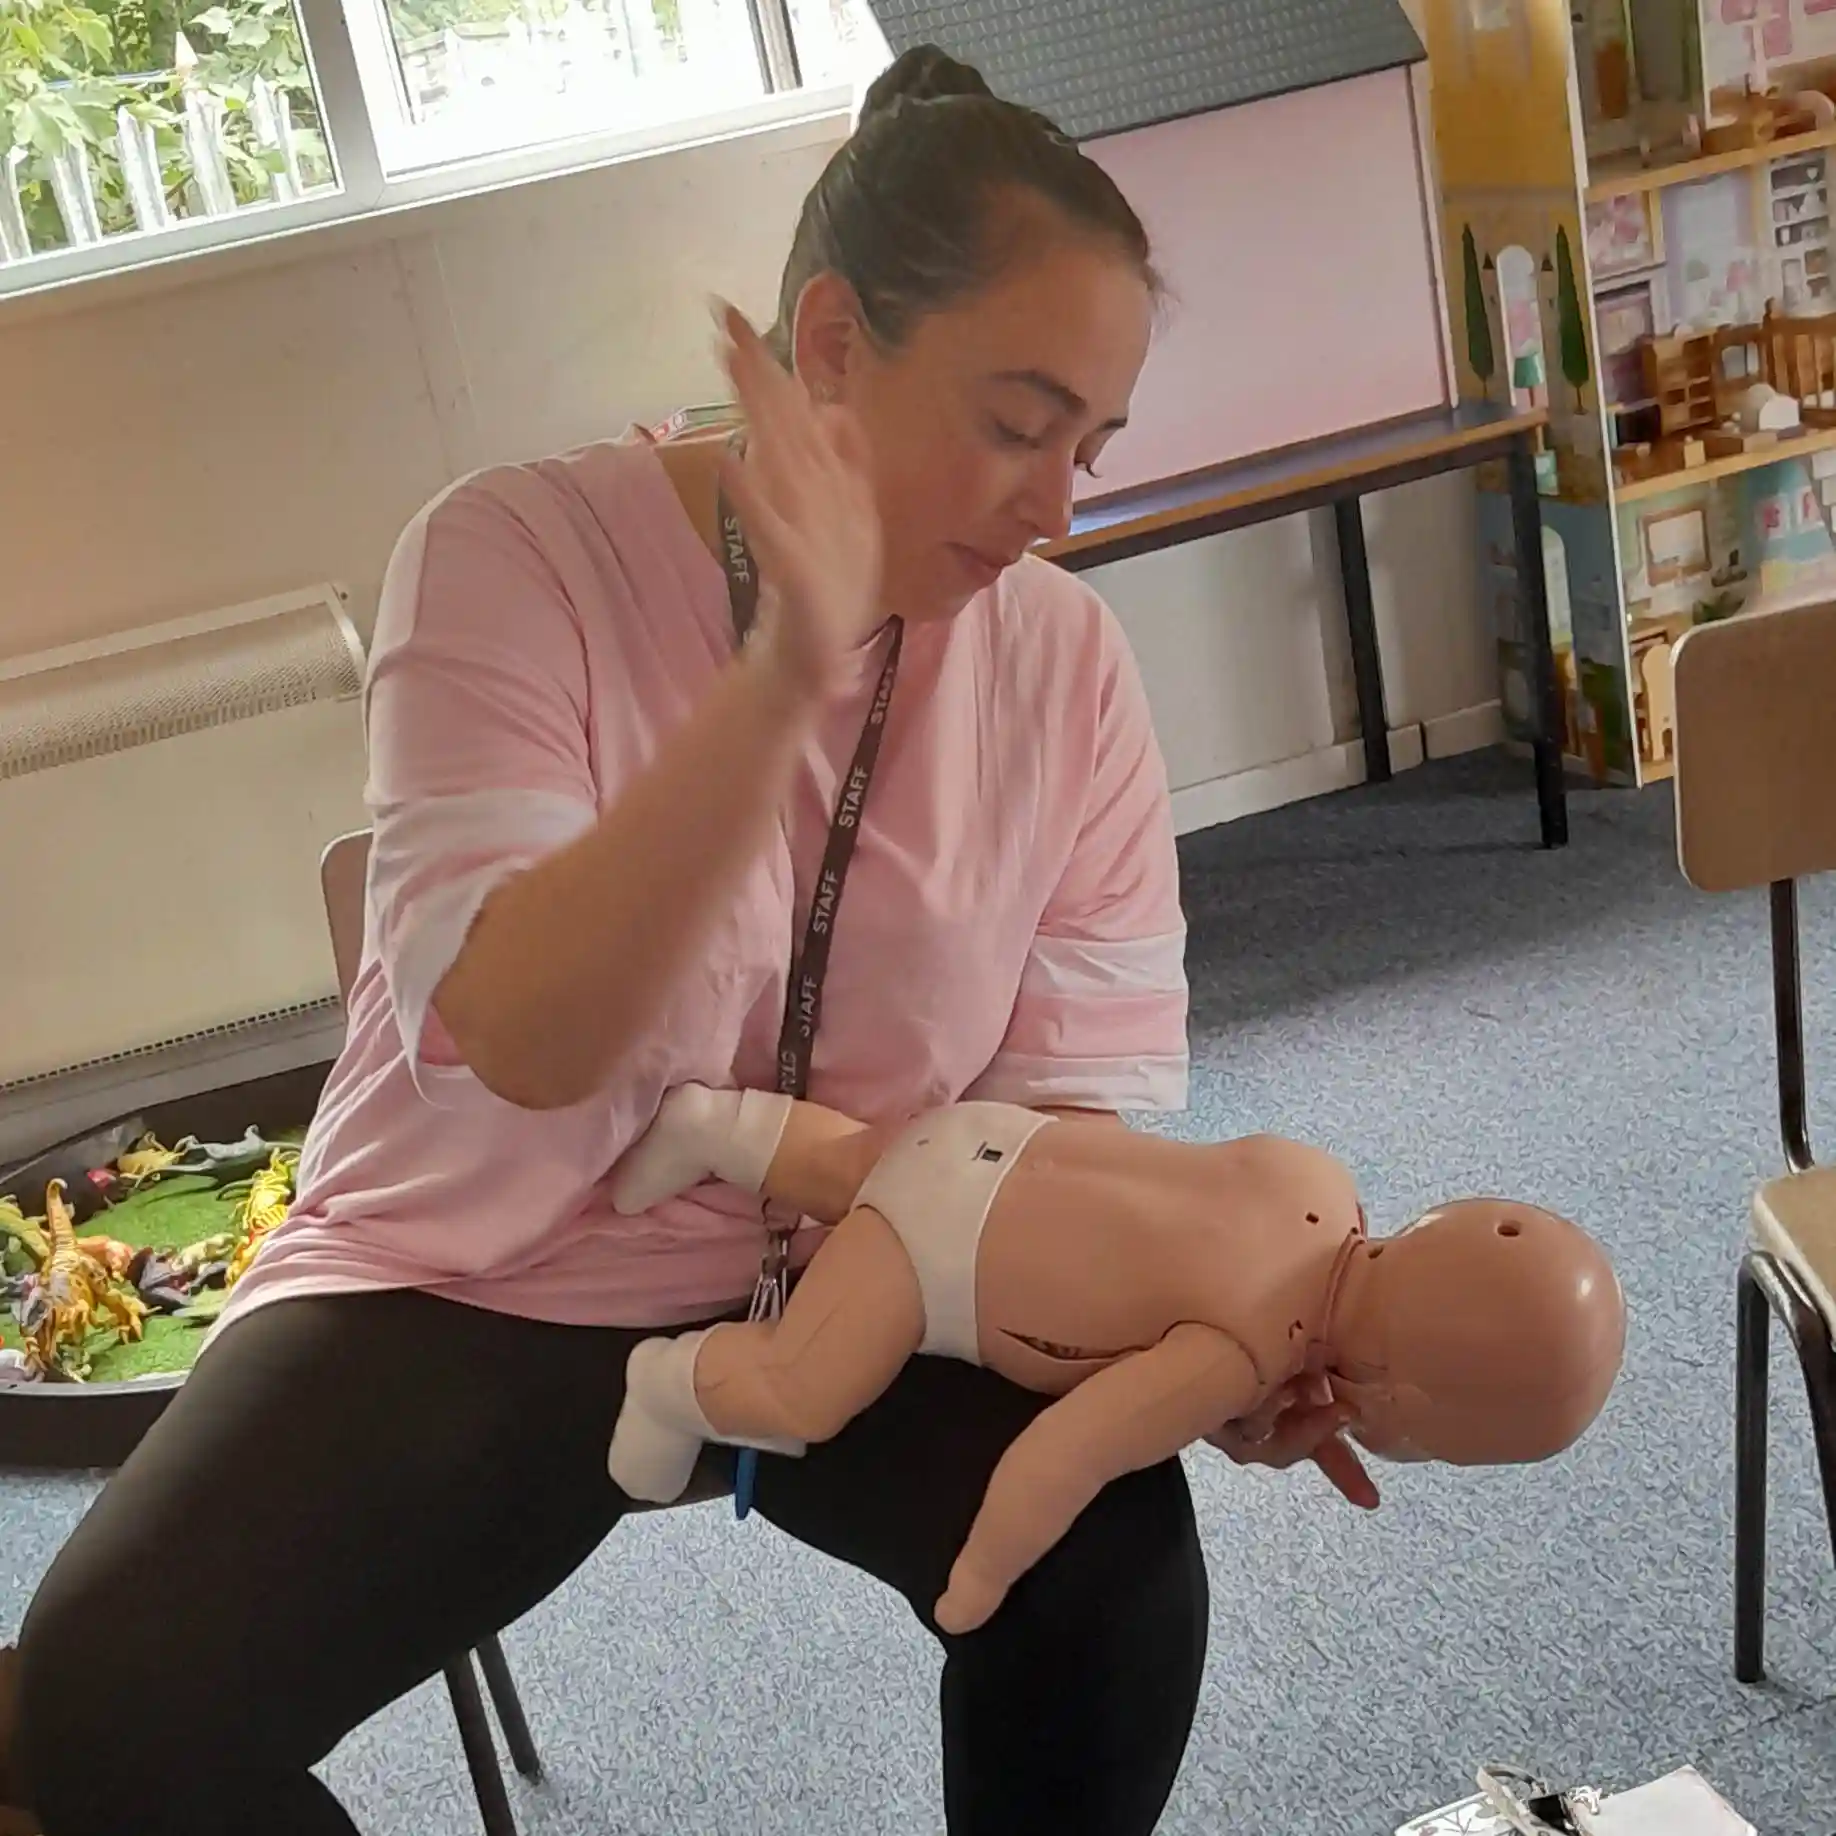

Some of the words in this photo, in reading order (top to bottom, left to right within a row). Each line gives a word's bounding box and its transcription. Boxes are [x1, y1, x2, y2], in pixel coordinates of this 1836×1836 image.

[724, 515, 750, 584] STAFF
[838, 765, 868, 828] STAFF
[813, 869, 838, 934] STAFF
